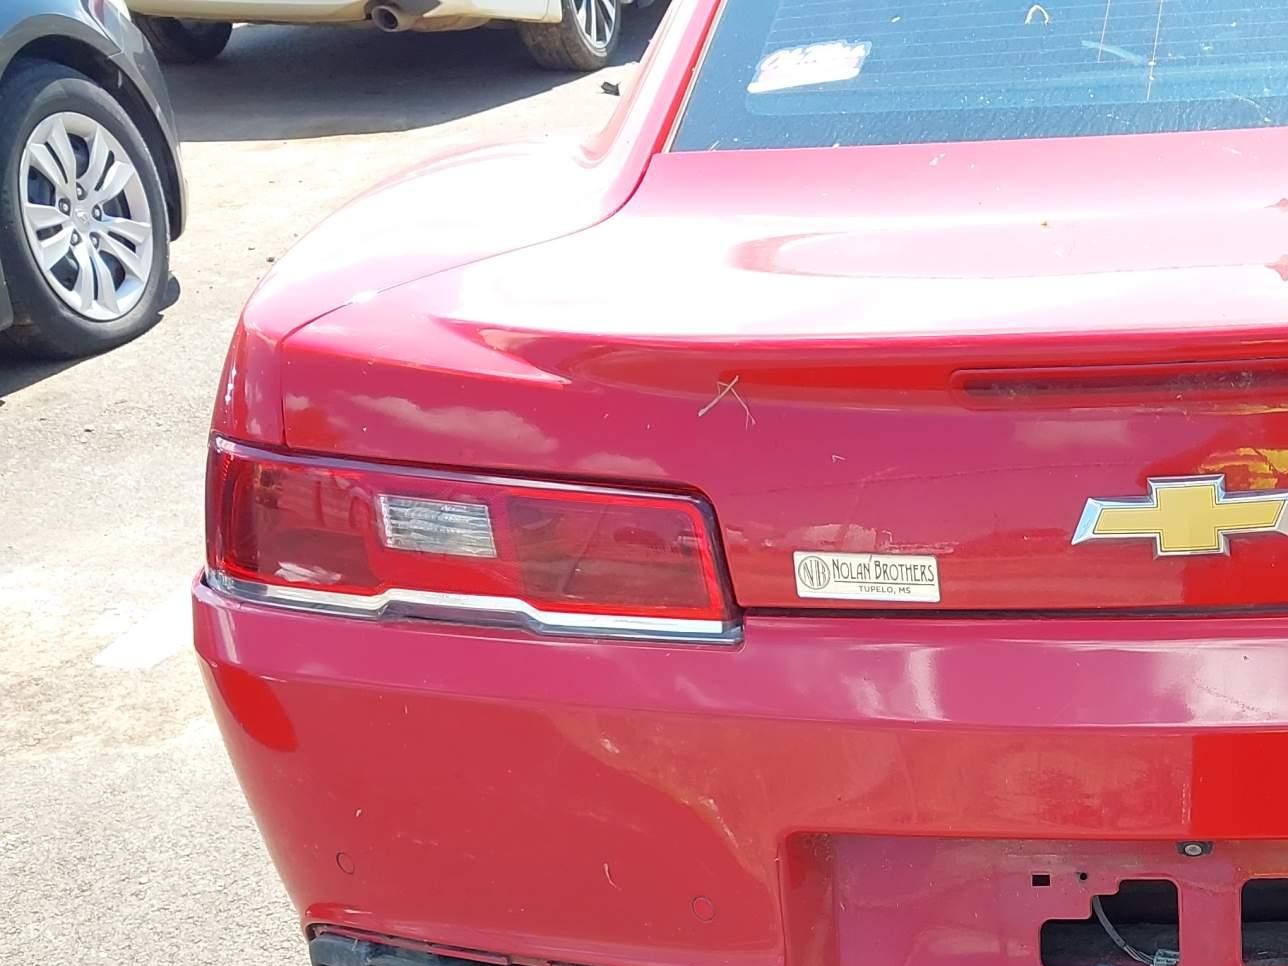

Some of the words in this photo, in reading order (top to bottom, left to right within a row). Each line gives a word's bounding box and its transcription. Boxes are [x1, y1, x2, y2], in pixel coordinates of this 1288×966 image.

[832, 558, 870, 580] NOLAN
[874, 560, 935, 582] BROTHERS
[858, 585, 897, 595] TUPELO,
[898, 586, 912, 594] MS
